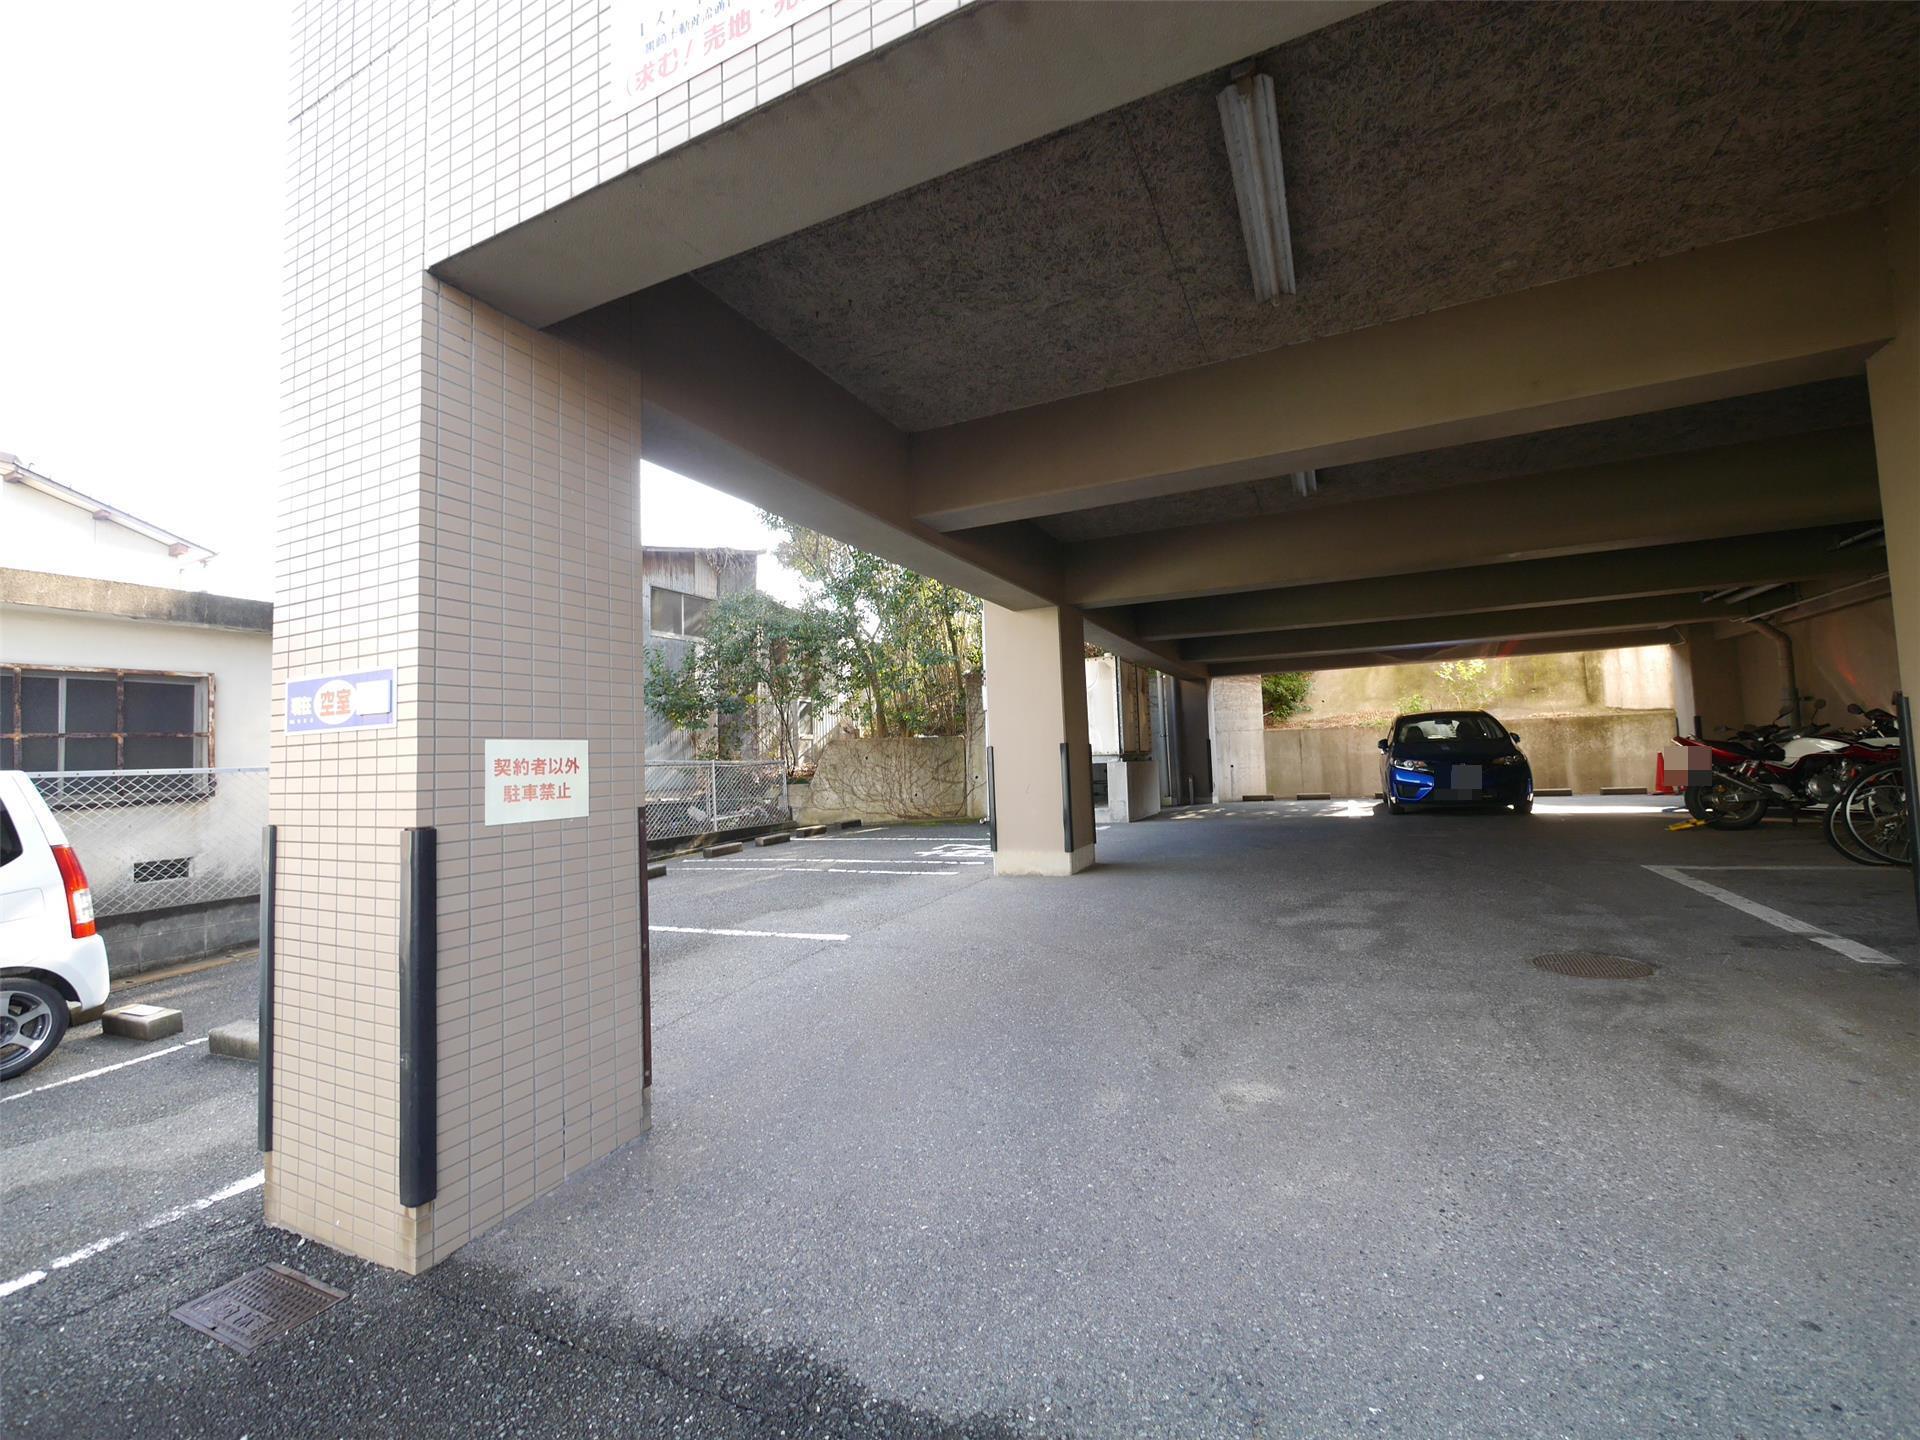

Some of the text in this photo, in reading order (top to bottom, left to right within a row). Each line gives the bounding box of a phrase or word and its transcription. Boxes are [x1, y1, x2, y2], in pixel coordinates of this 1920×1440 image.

[319, 688, 353, 717] 空室
[493, 756, 580, 777] 契約者以外
[503, 781, 572, 804] 駐車禁止
